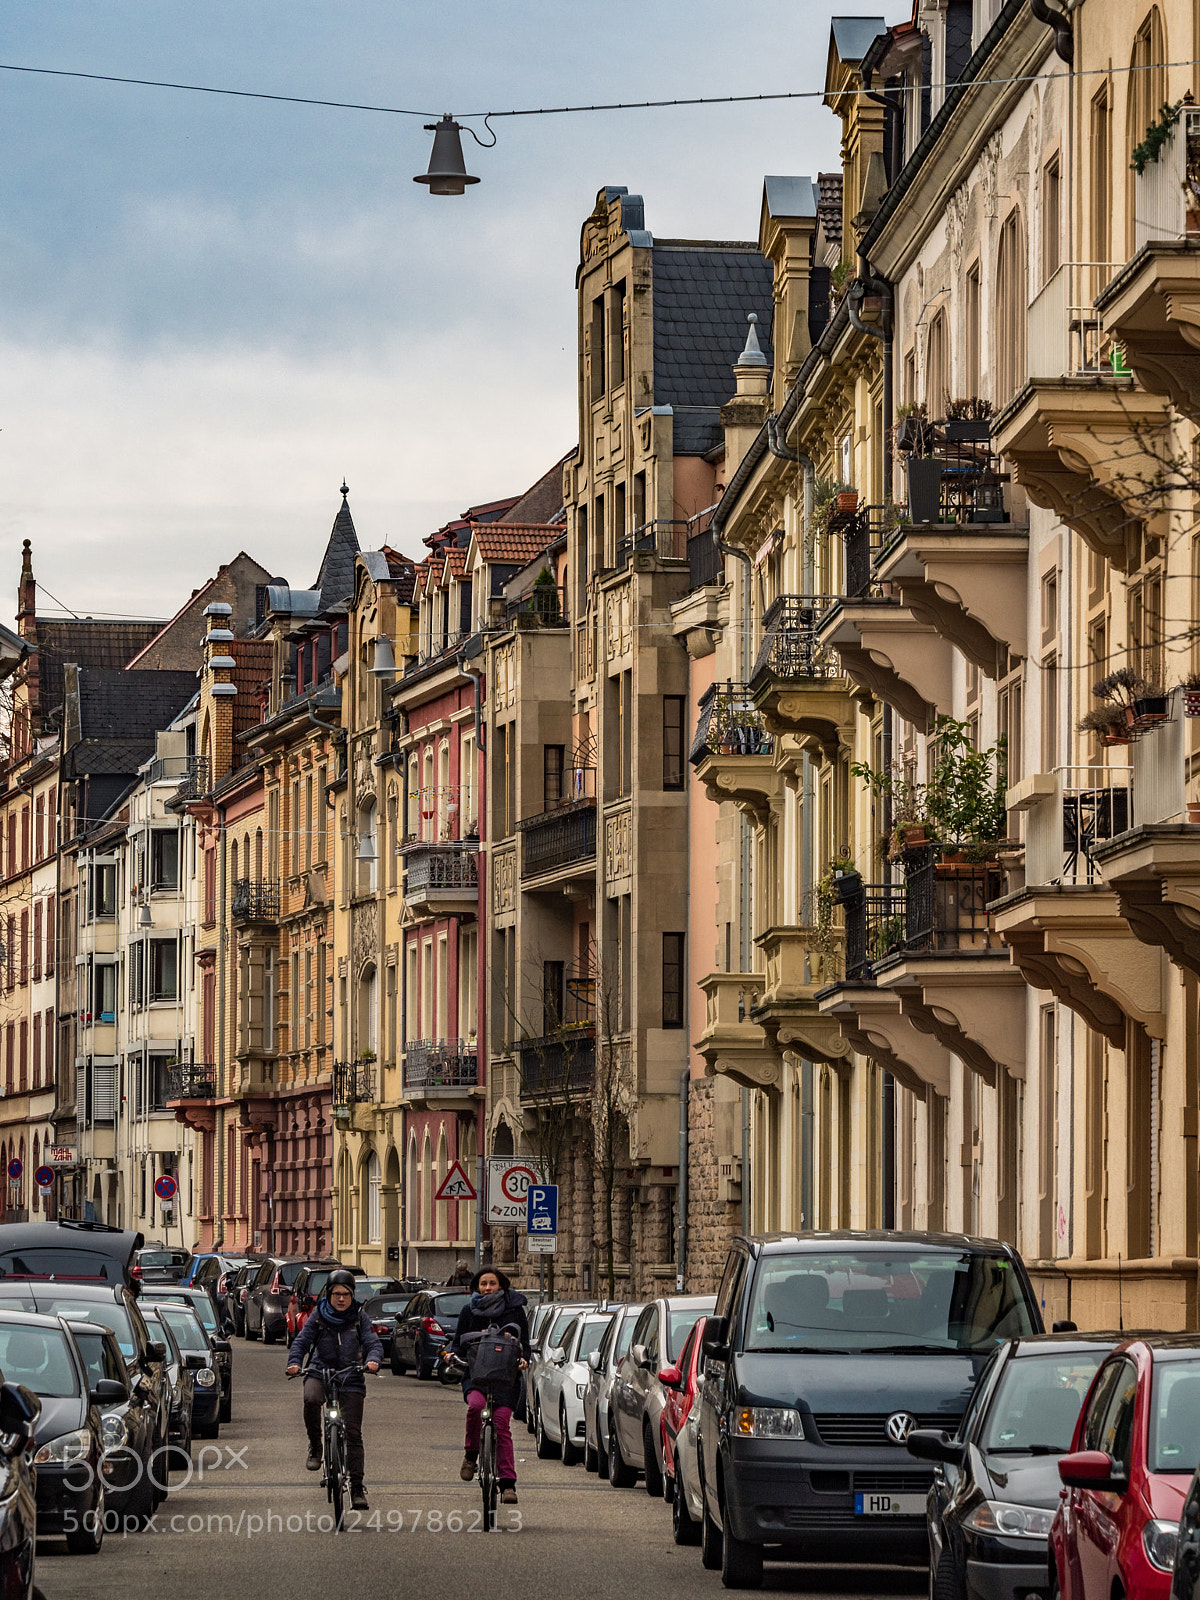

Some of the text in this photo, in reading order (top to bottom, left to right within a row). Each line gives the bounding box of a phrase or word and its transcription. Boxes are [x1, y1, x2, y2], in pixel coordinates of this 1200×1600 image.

[509, 1176, 530, 1193] 30
[532, 1189, 546, 1210] P
[503, 1206, 527, 1217] ZON
[870, 1496, 891, 1512] HD
